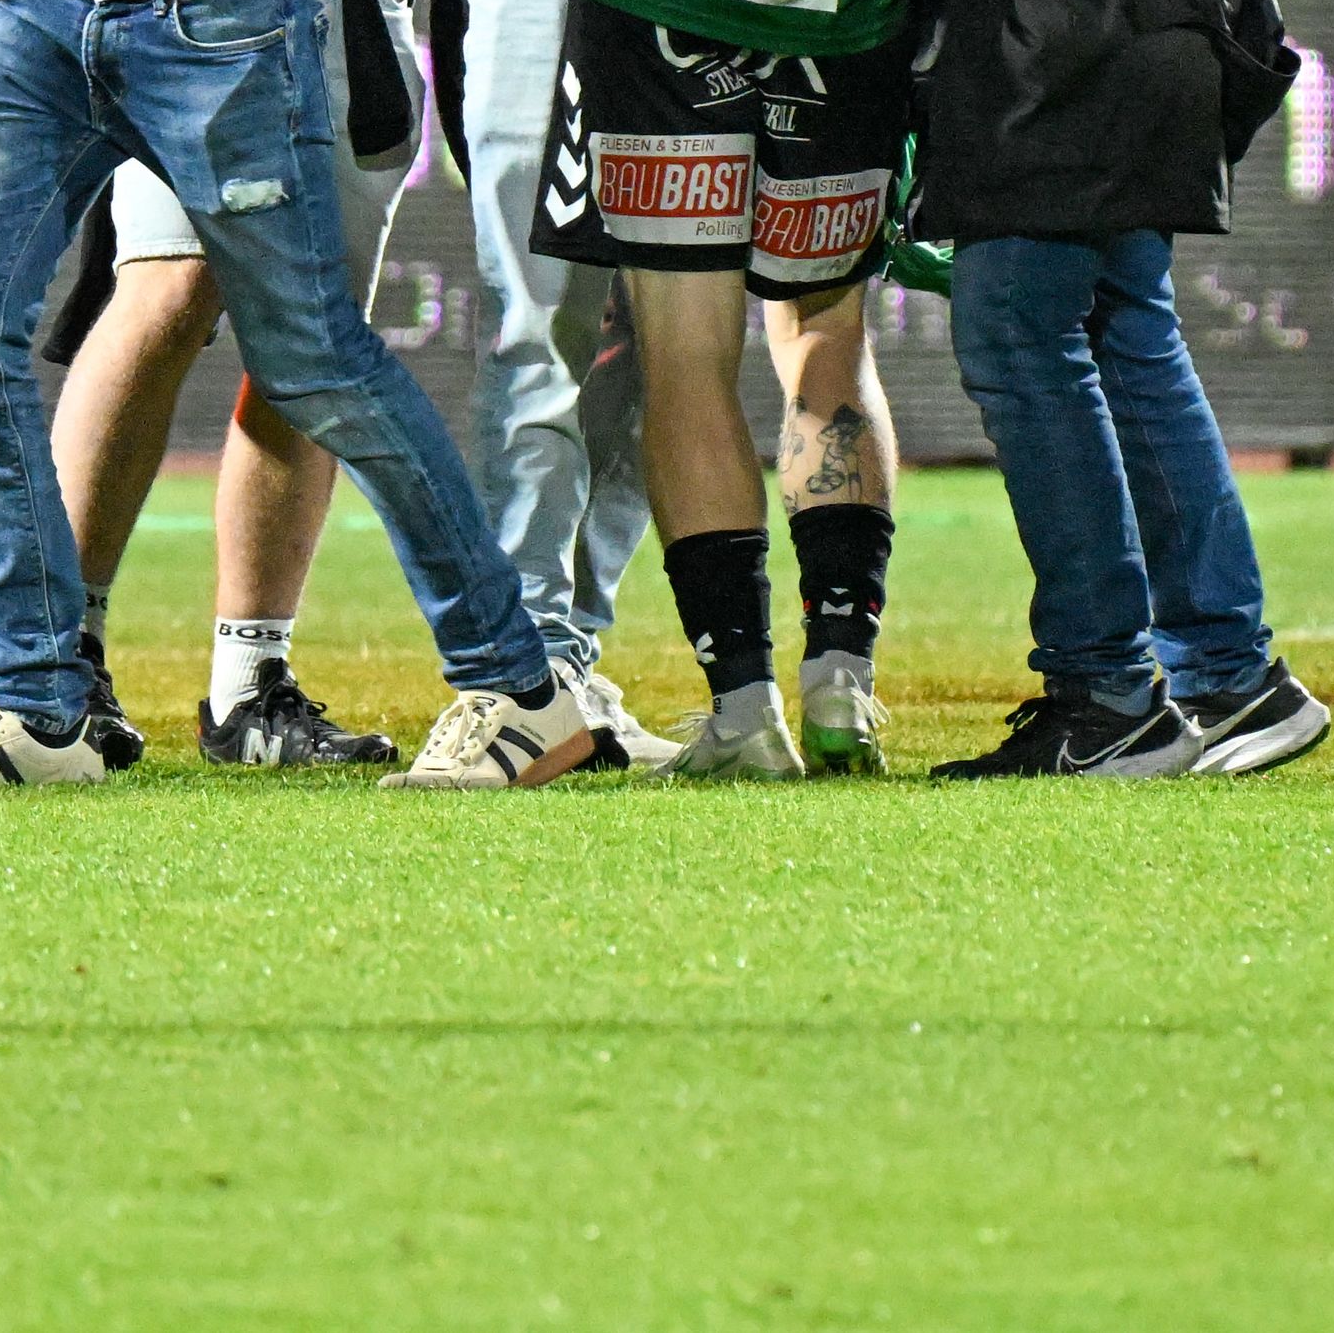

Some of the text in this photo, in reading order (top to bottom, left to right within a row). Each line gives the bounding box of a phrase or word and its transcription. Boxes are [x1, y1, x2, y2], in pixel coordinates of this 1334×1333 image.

[705, 66, 750, 97] STEA
[600, 138, 651, 151] FLIESEN
[672, 139, 715, 152] STEIN
[603, 162, 747, 211] BAUBAST
[820, 178, 854, 193] STEIN
[696, 221, 743, 238] Polling
[753, 197, 876, 253] BAUBAST
